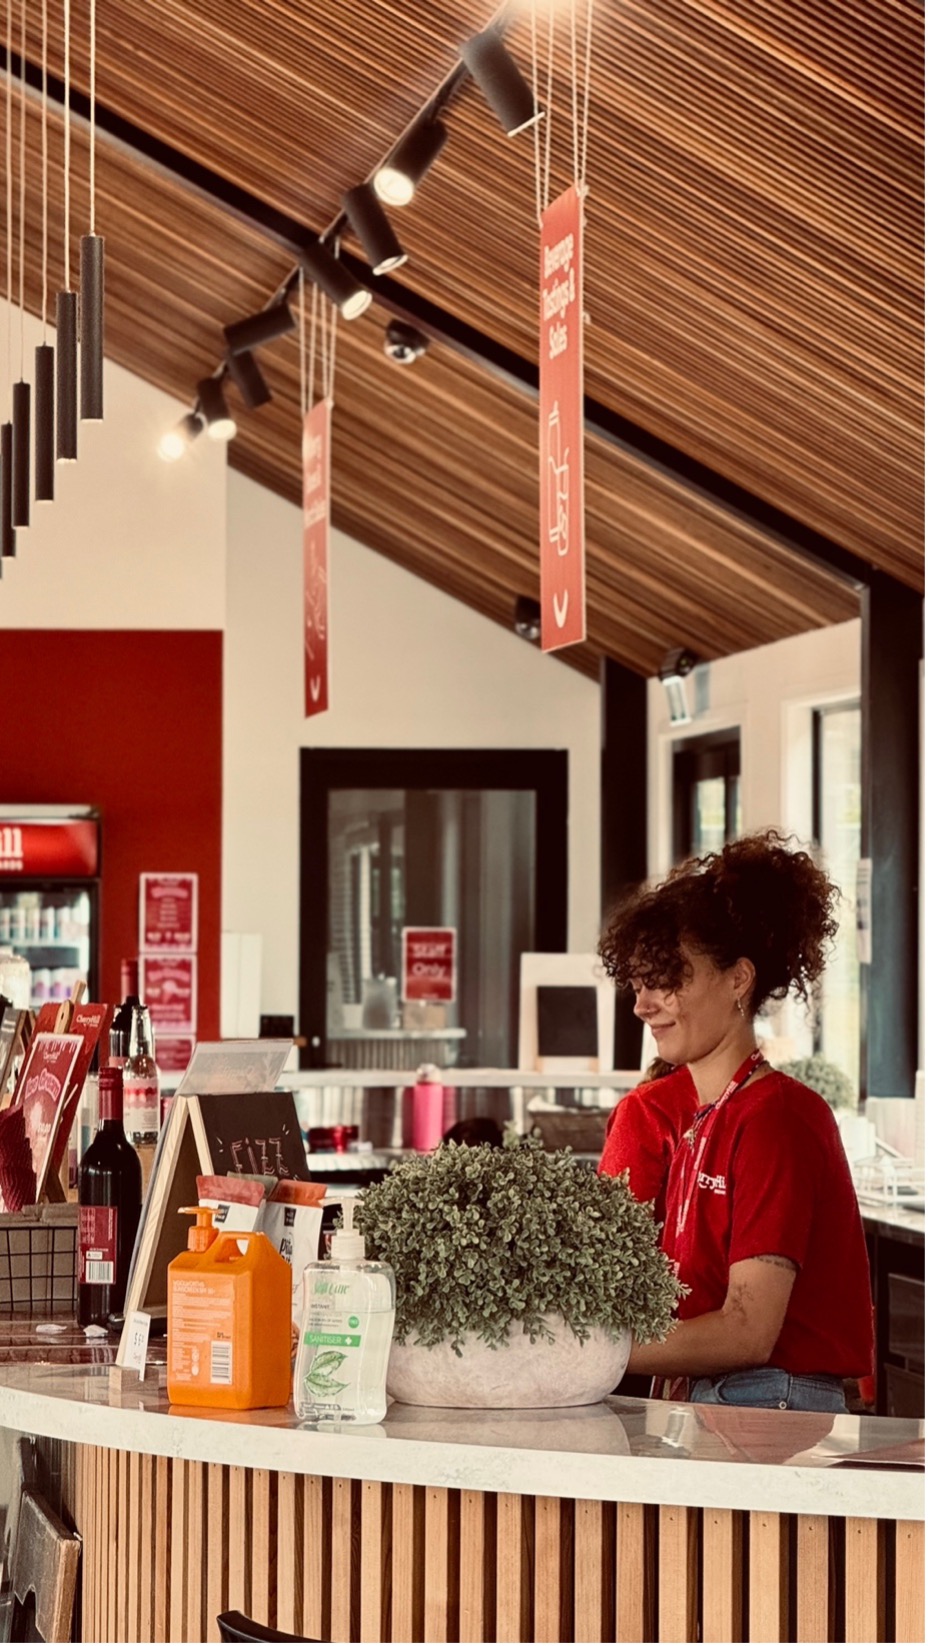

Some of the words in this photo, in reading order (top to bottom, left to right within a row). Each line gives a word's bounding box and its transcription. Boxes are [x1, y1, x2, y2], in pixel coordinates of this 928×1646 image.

[413, 943, 446, 958] Staff
[412, 962, 446, 979] Only
[309, 1334, 342, 1345] SANITISER
